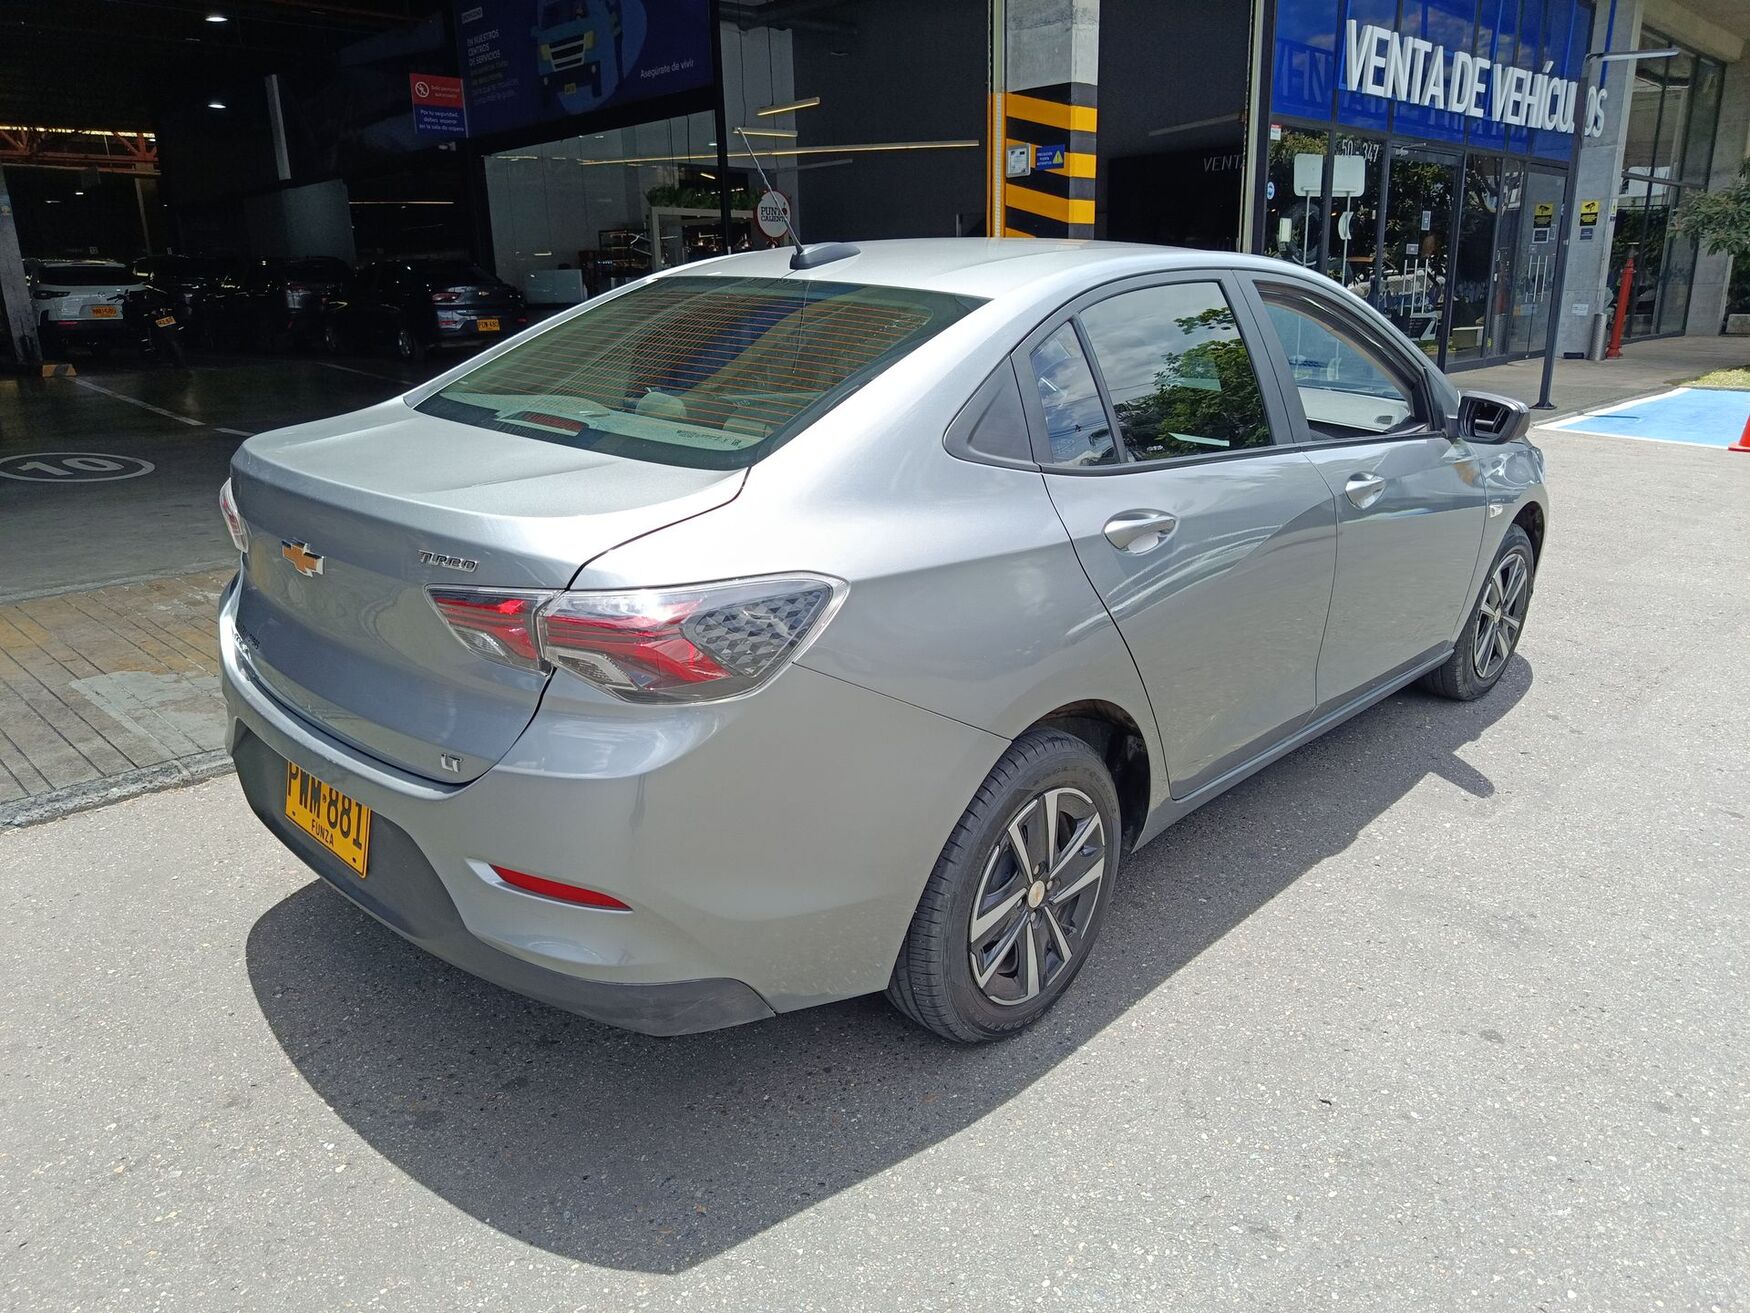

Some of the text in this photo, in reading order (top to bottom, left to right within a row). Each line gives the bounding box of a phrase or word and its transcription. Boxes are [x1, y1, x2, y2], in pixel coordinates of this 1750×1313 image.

[1346, 19, 1607, 138] VENTA DE VEHÍCULOS
[1363, 142, 1379, 162] 347
[1203, 154, 1244, 172] VENT
[16, 457, 125, 476] 10
[416, 549, 480, 573] TURBO
[440, 752, 464, 773] LT
[311, 818, 335, 847] FUNZA
